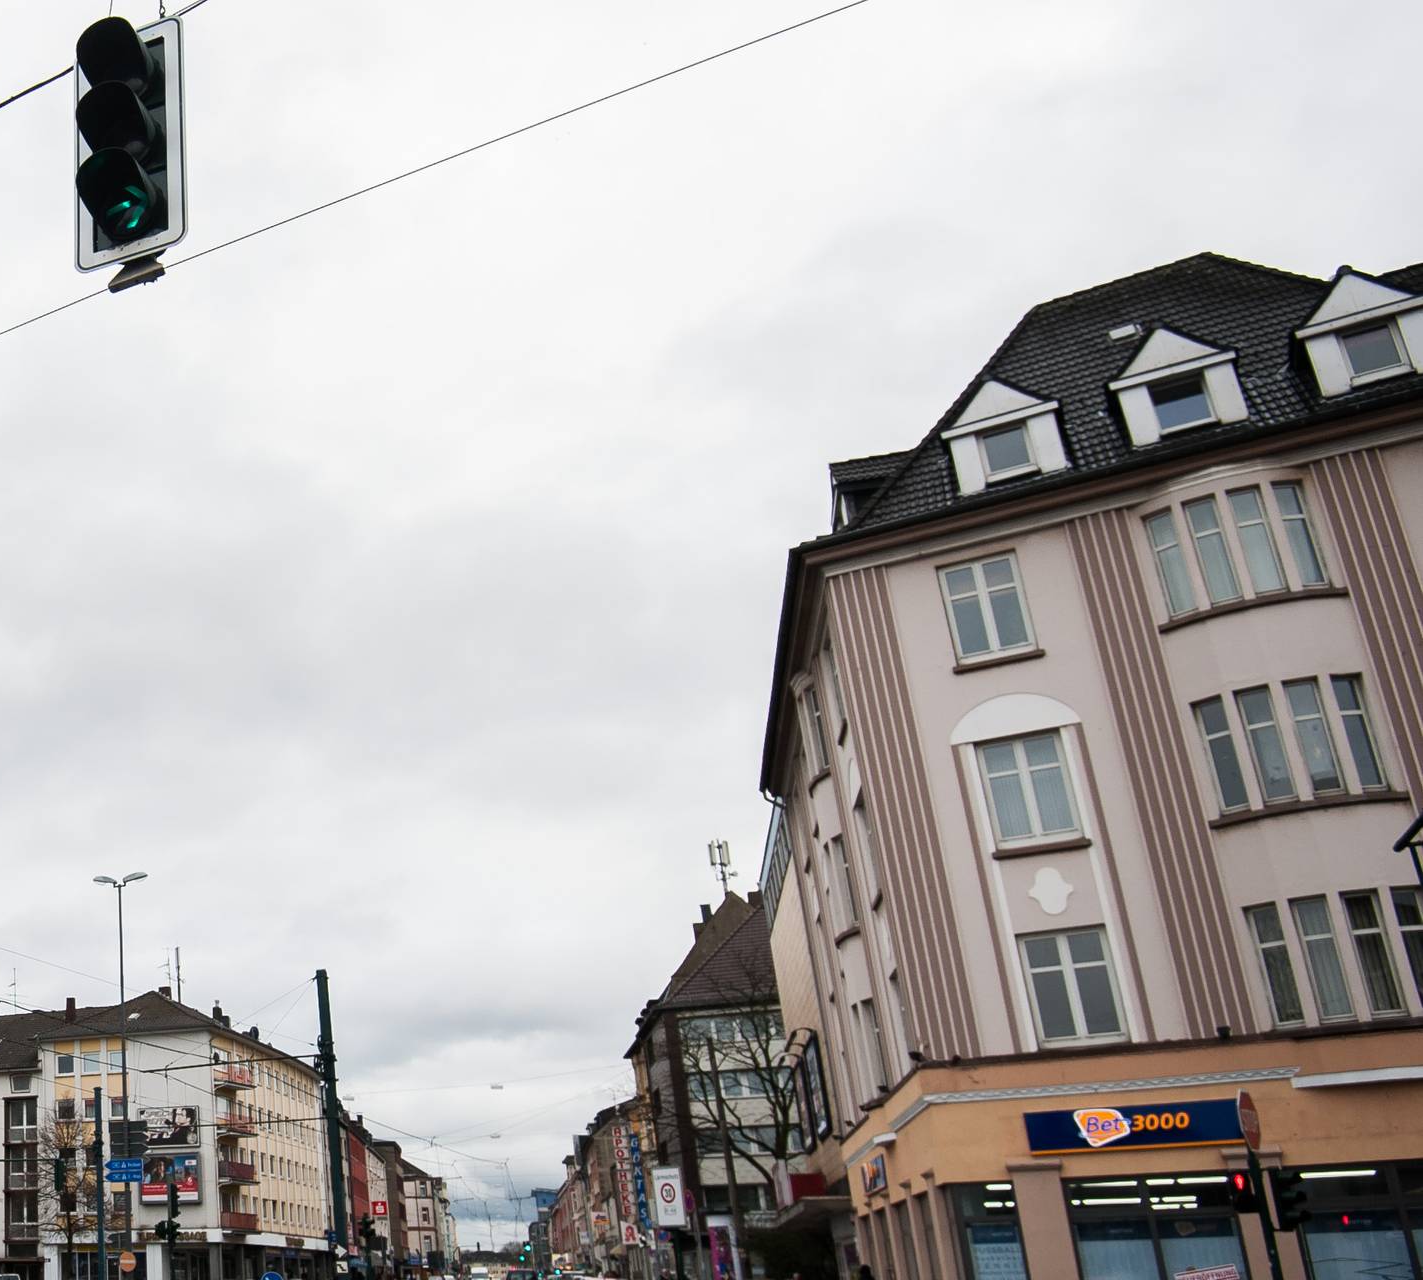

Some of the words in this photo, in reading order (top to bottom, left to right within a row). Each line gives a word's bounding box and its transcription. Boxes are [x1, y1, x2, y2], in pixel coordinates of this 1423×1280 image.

[1086, 1116, 1121, 1133] Bet
[1132, 1112, 1190, 1131] 3000
[613, 1128, 631, 1215] APOTHEKE
